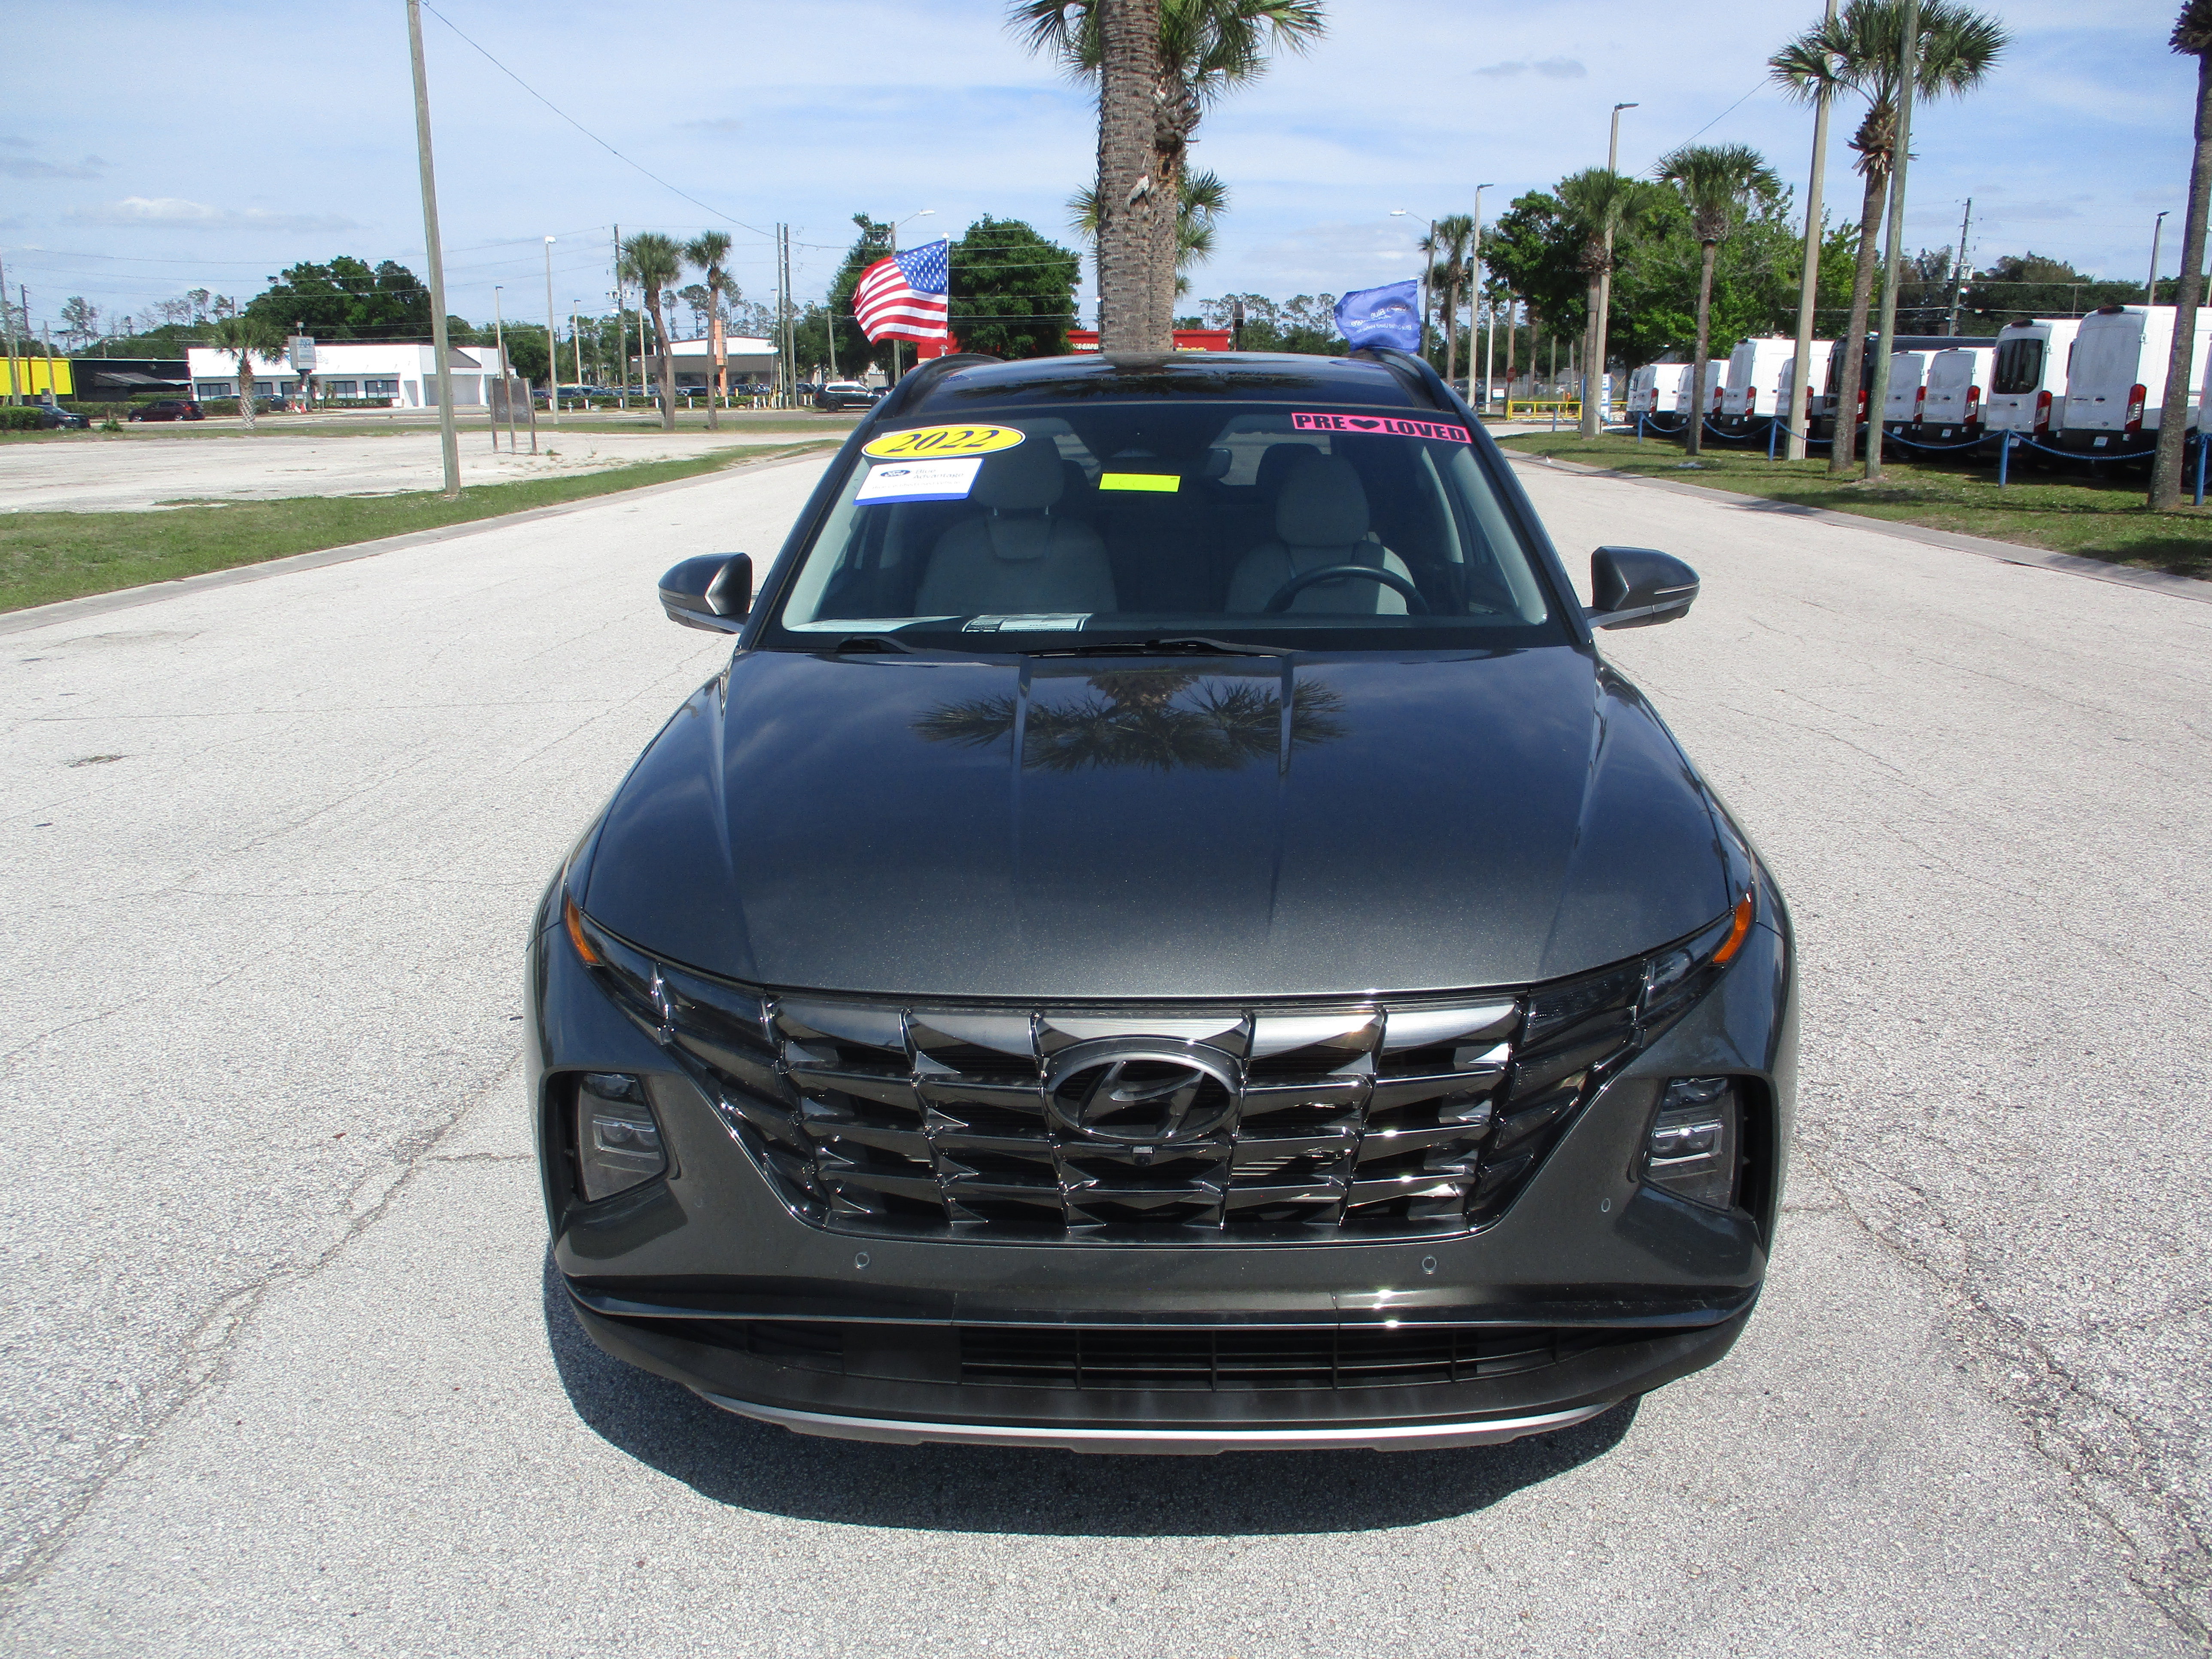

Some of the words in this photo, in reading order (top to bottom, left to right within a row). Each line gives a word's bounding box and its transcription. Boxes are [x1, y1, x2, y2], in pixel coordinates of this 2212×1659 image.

[1294, 415, 1347, 429] PRE
[1383, 419, 1467, 441] LOVED
[884, 430, 1000, 454] 2022
